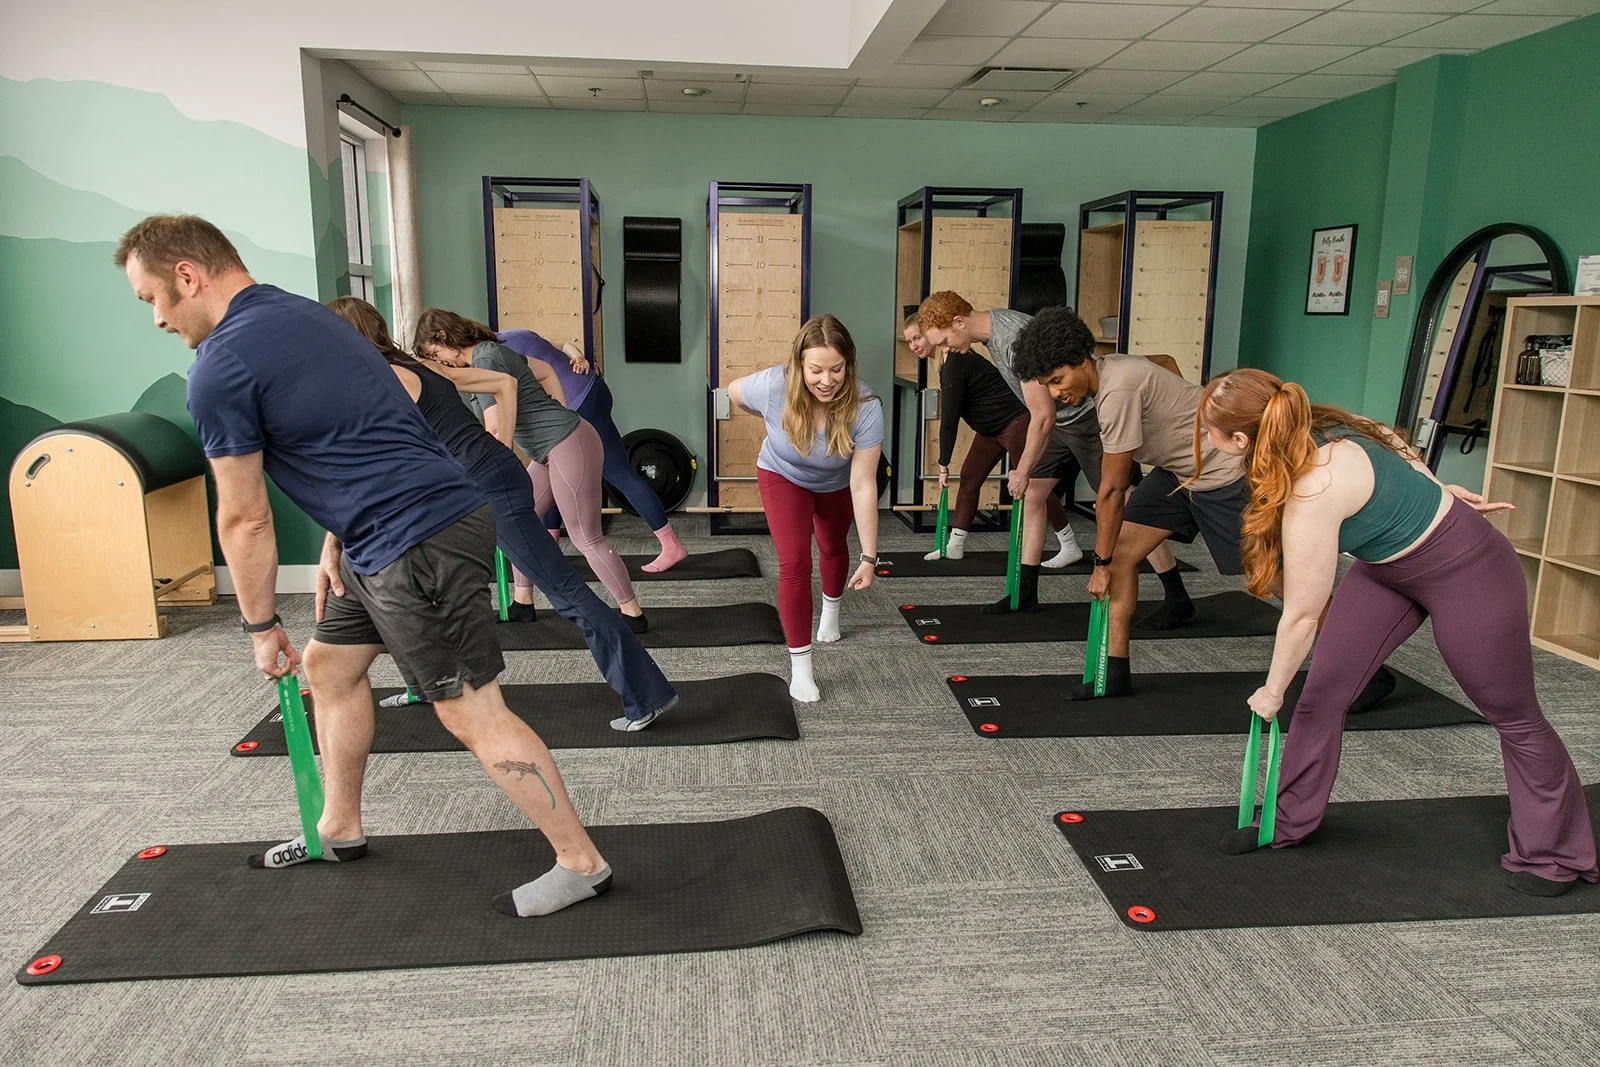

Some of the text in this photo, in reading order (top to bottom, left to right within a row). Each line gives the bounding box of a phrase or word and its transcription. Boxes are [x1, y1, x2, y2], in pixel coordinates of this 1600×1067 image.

[533, 231, 541, 239] 11
[534, 257, 545, 266] 10
[755, 261, 766, 269] 10
[536, 284, 543, 292] 9
[757, 286, 763, 294] 9
[1097, 644, 1108, 694] SYNERGEE
[272, 843, 324, 865] adid
[1103, 857, 1130, 869] T
[102, 896, 135, 911] T
